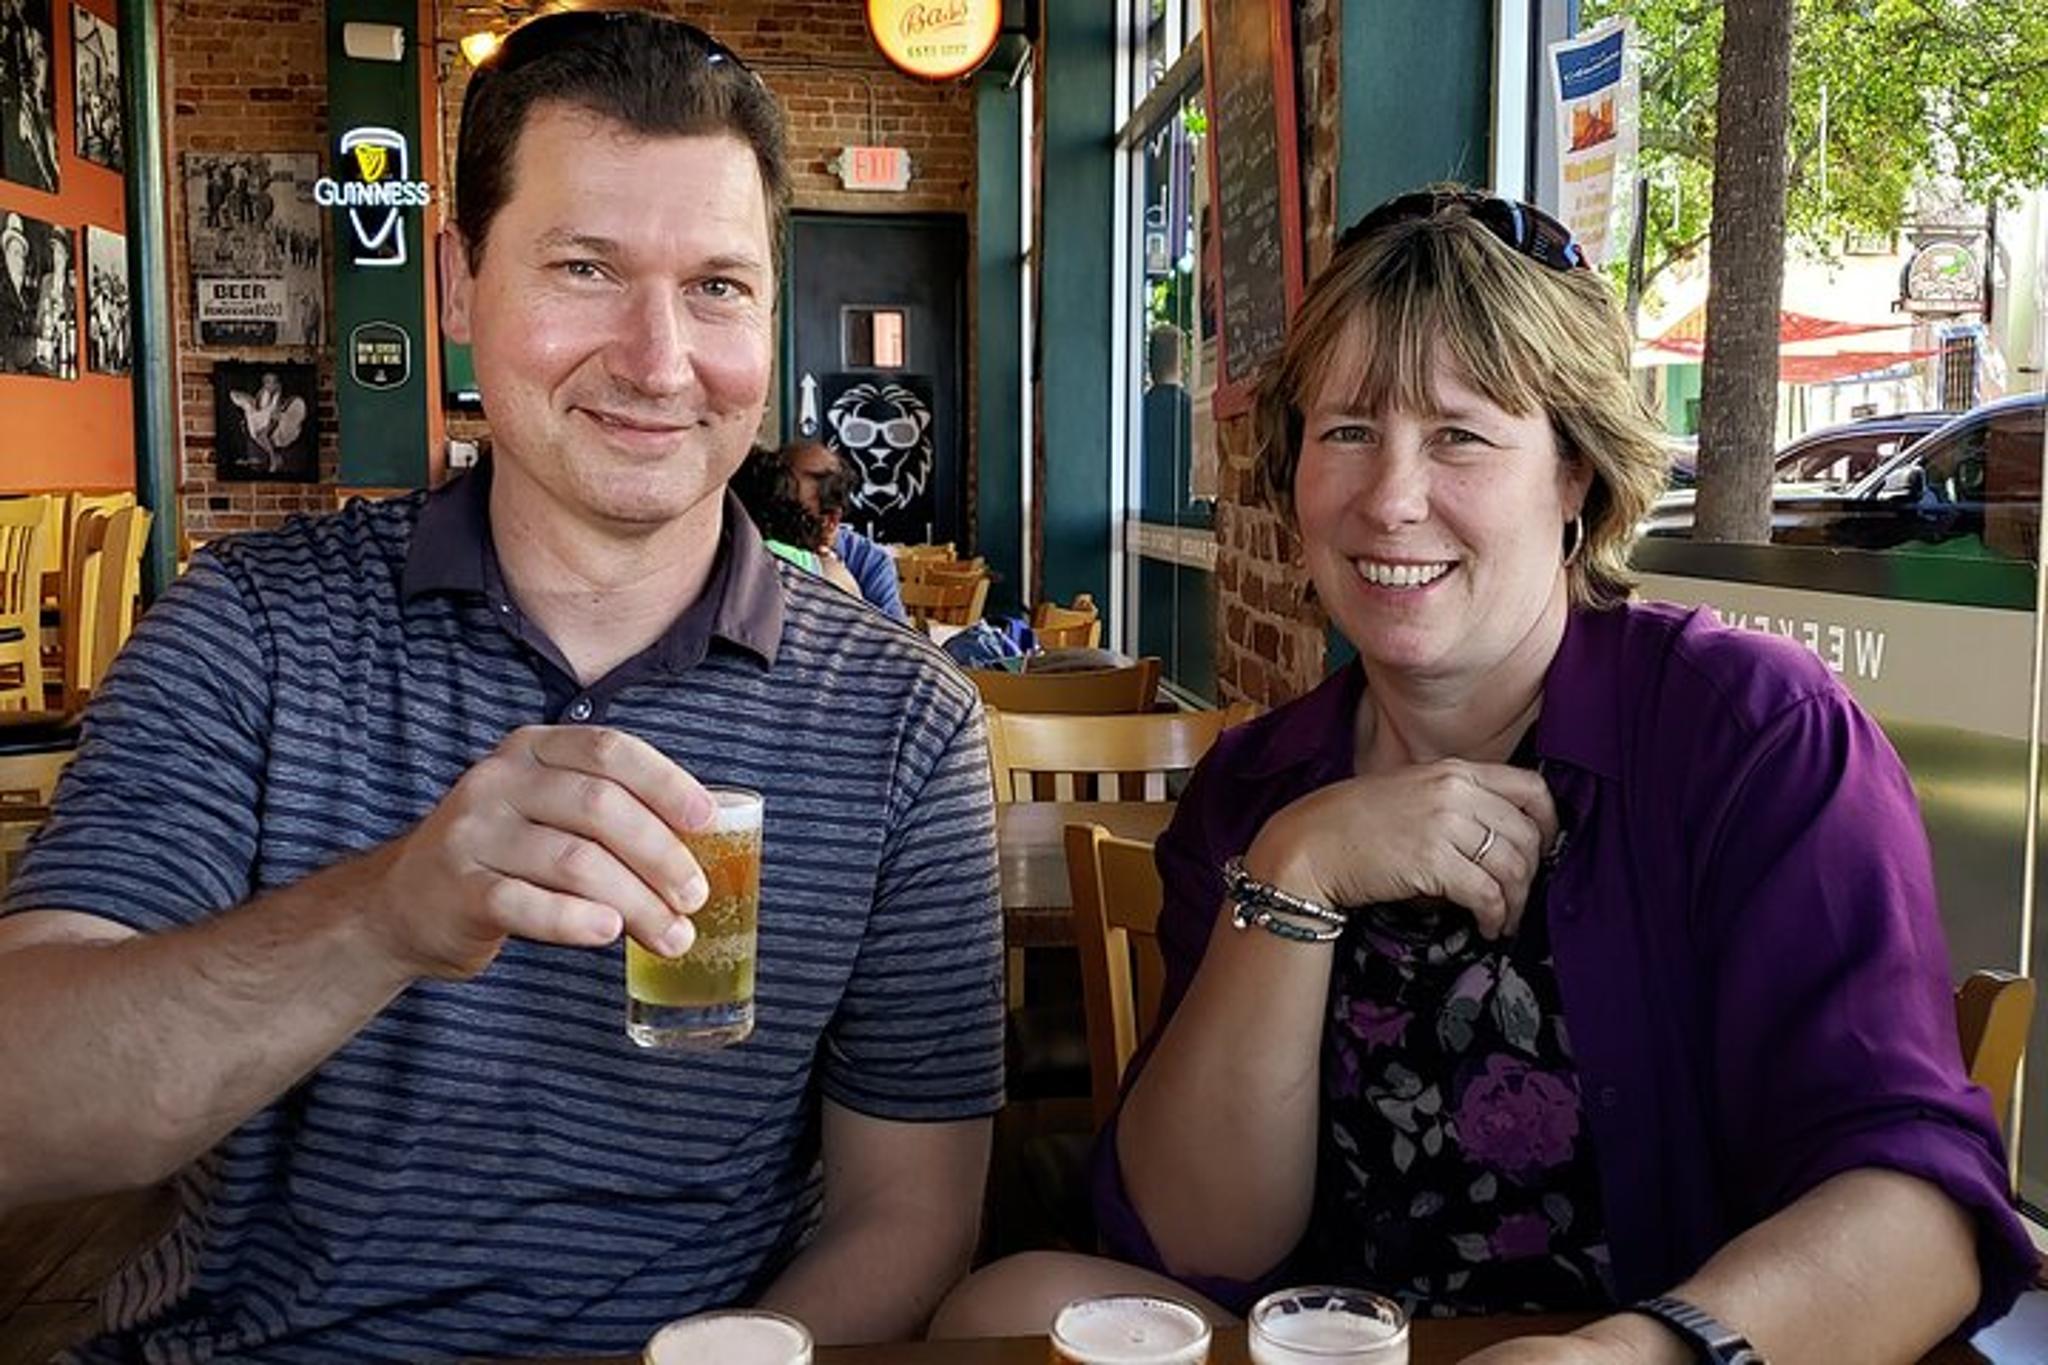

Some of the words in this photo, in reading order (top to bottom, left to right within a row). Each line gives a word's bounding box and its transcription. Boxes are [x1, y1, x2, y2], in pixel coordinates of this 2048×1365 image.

[854, 150, 897, 182] EXIT
[314, 177, 430, 206] GUINNESS
[213, 283, 267, 299] BEER
